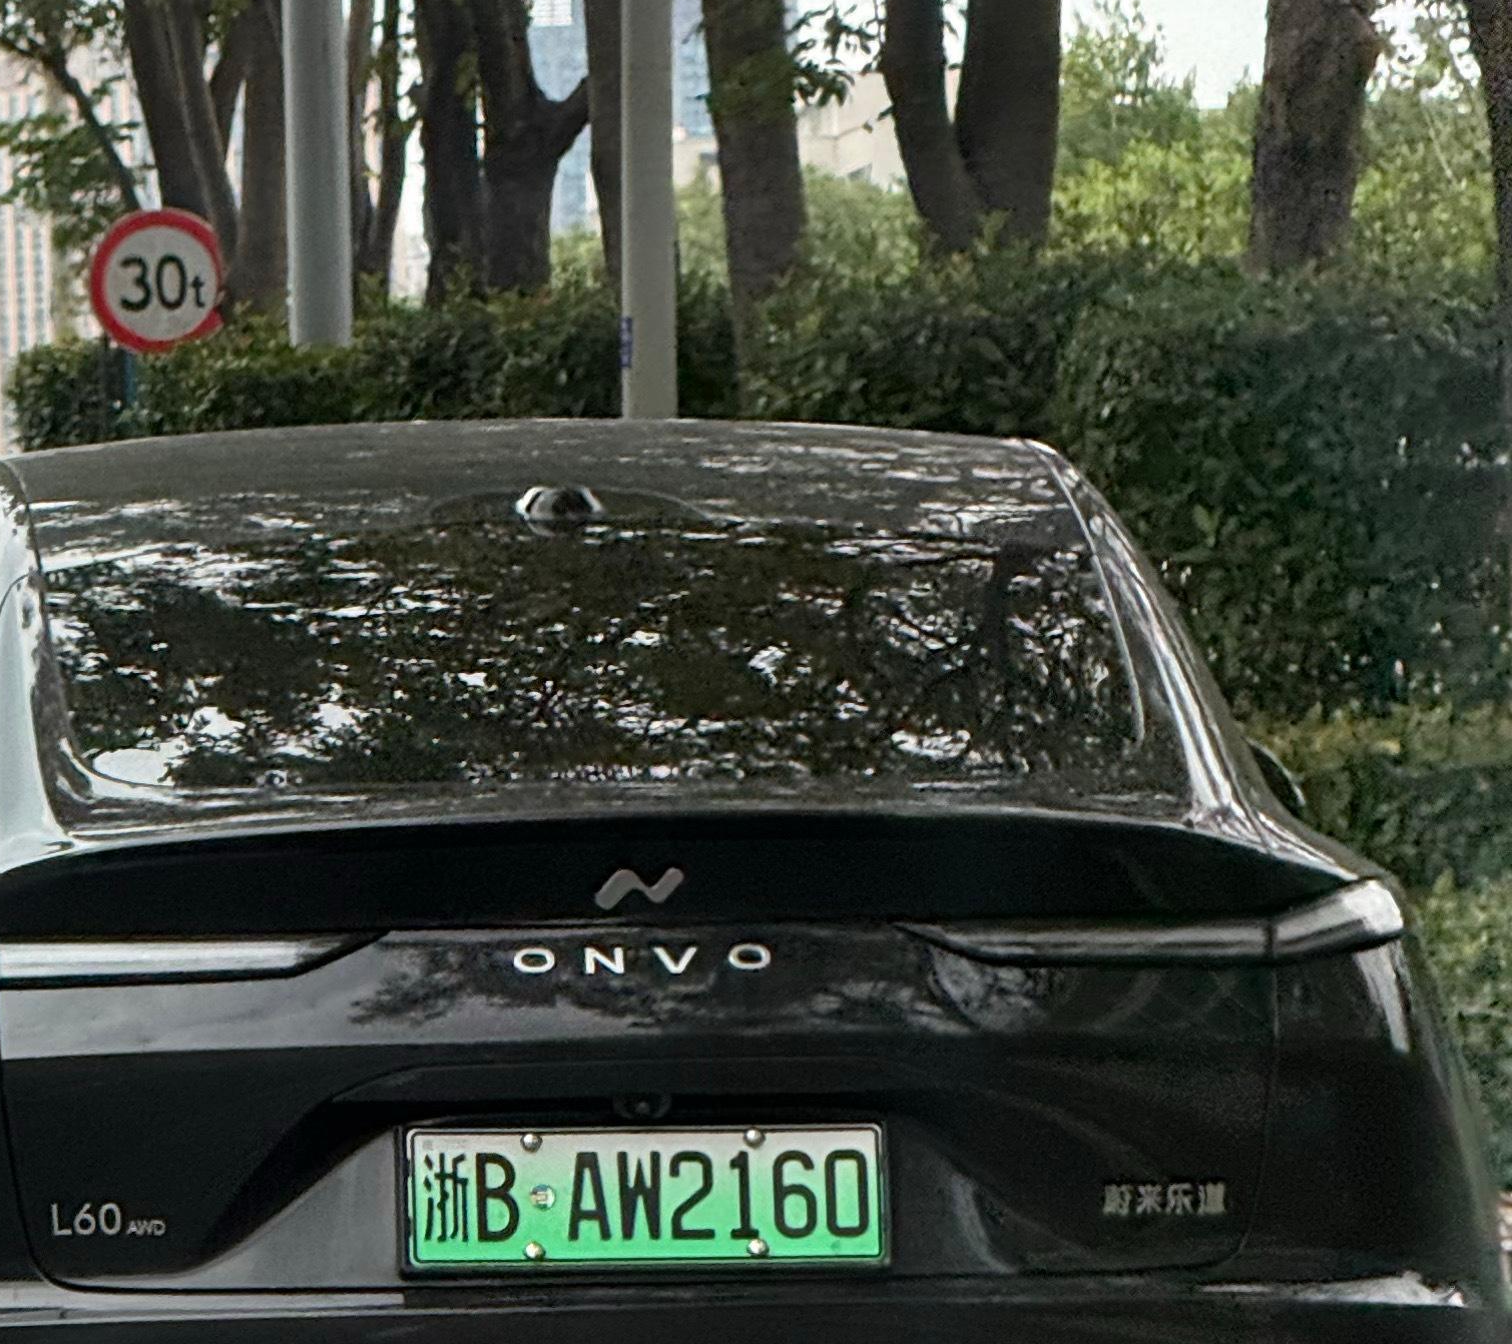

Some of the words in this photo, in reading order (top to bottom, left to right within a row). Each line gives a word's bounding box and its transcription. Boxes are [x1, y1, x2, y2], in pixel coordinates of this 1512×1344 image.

[119, 254, 205, 312] 30t
[513, 943, 771, 975] ONVO
[51, 1202, 121, 1236] L60
